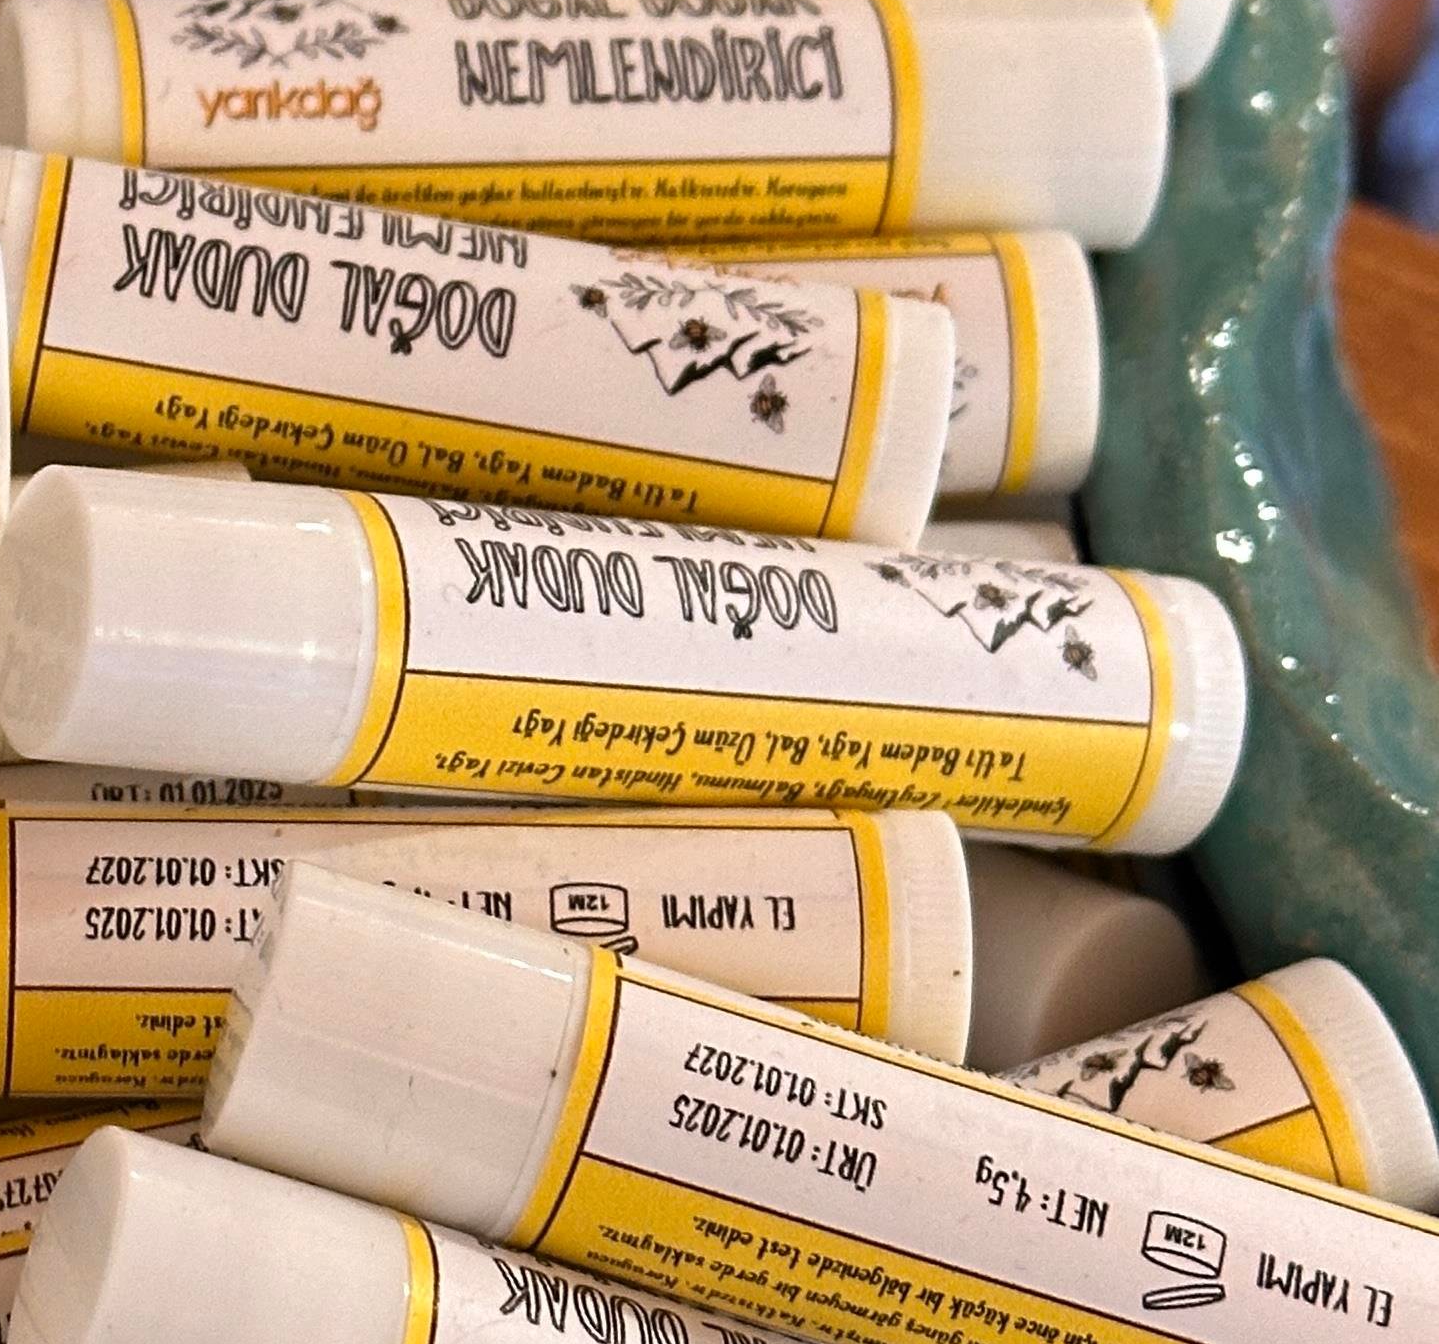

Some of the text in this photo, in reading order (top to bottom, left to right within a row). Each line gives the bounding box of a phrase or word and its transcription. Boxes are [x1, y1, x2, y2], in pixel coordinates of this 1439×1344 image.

[113, 224, 309, 323] DUDAK
[454, 538, 644, 619] DUDAK
[880, 743, 960, 777] Badem
[86, 856, 216, 886] 01.01.2027
[85, 907, 216, 942] 01.01.2025
[568, 894, 795, 931] EL YAPIMI 12M
[684, 1043, 887, 1130] SKT: 01.01.2027
[669, 1094, 877, 1193] ÜRT: 01.01.2025
[976, 1155, 1393, 1327] EL YAPIMI 12M NET: 4,5g
